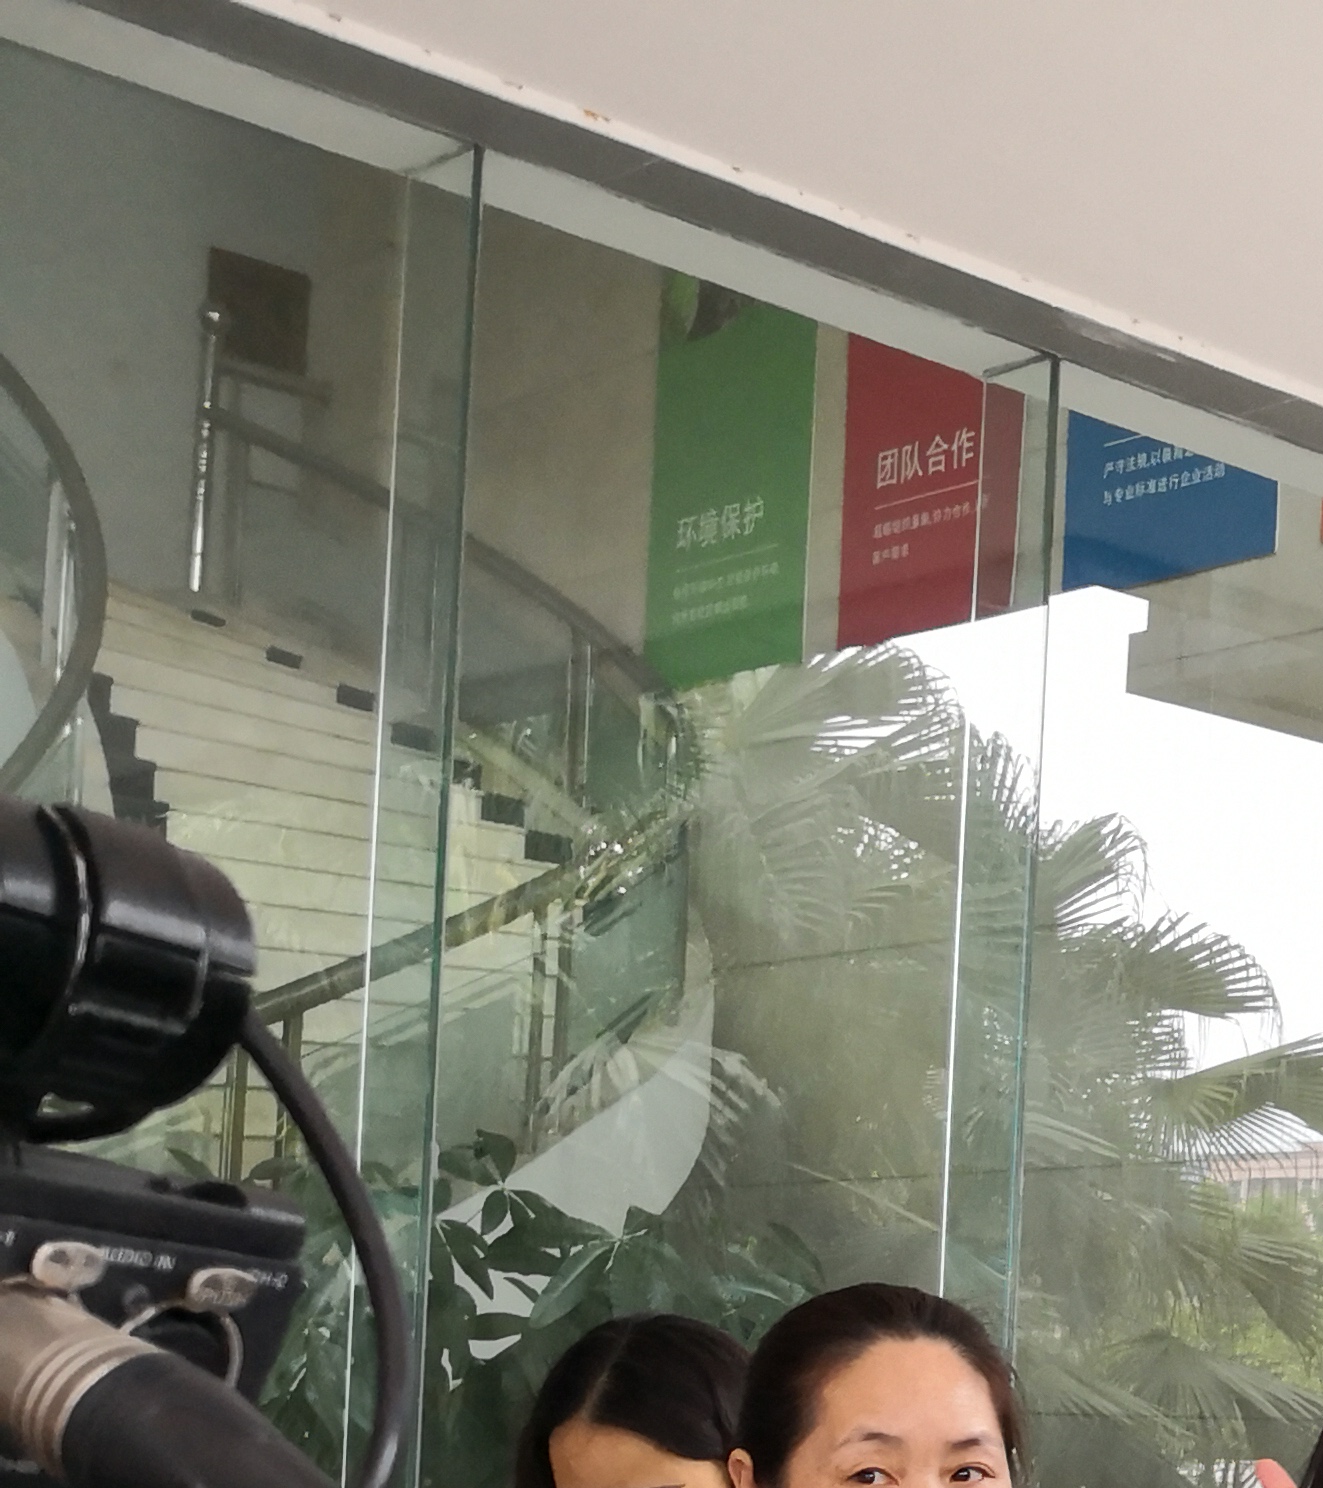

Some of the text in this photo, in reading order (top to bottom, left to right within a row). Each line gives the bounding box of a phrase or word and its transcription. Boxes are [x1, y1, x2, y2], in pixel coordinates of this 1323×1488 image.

[876, 427, 976, 489] 团队合作
[676, 496, 765, 549] 环境保护
